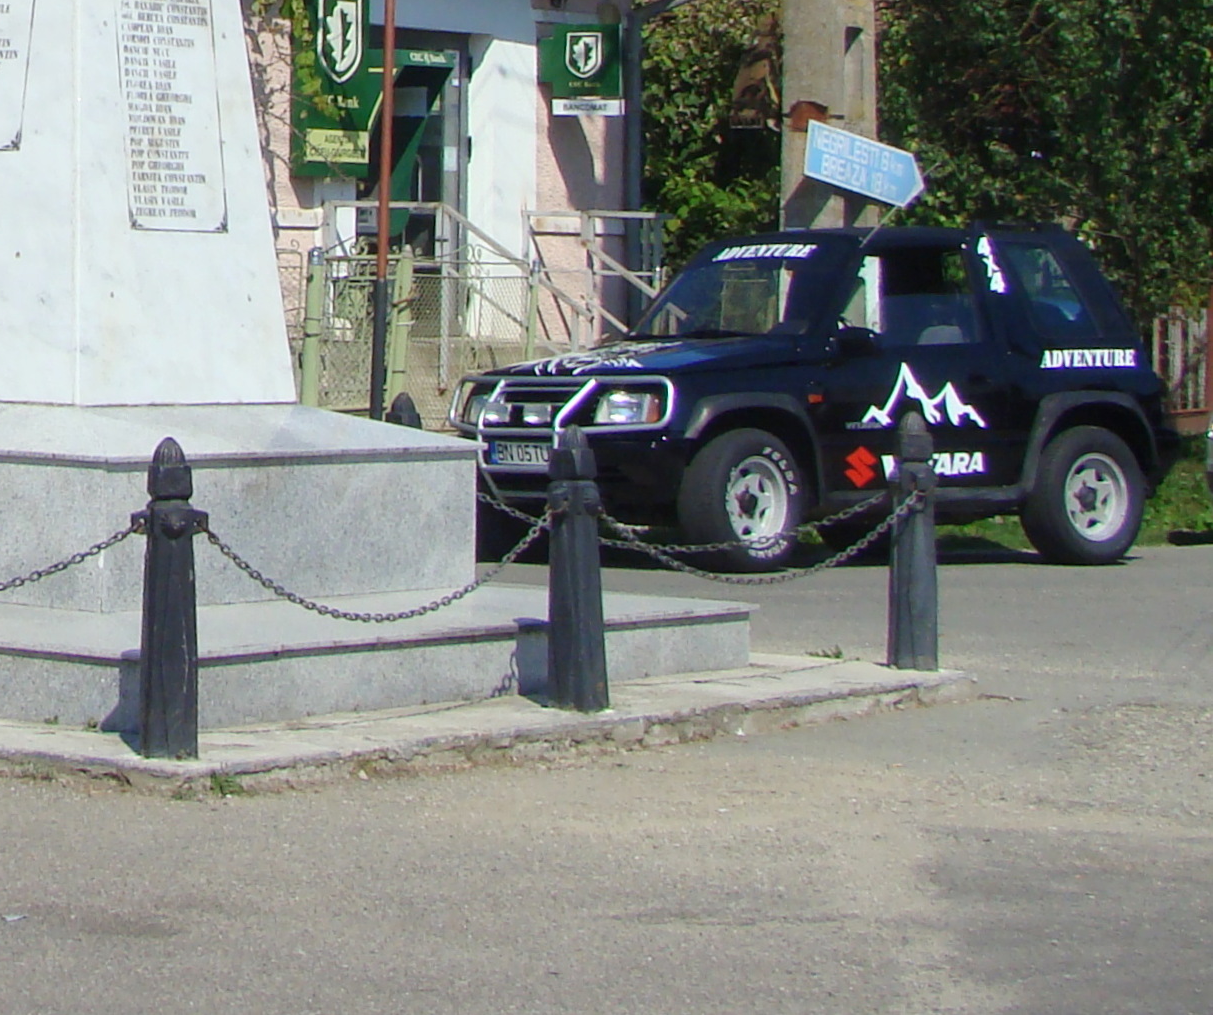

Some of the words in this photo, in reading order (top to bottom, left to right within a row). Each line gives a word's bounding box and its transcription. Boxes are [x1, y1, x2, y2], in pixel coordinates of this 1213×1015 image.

[167, 4, 208, 16] CONSTANTIN
[167, 15, 208, 26] CONSTANTIN
[563, 103, 607, 112] BANCOMAT
[147, 150, 189, 159] CONSTANTIN
[821, 153, 868, 190] BREAZA
[164, 175, 206, 183] CONSTANTIN
[1040, 349, 1136, 369] ADVENTURE
[497, 443, 514, 461] BN
